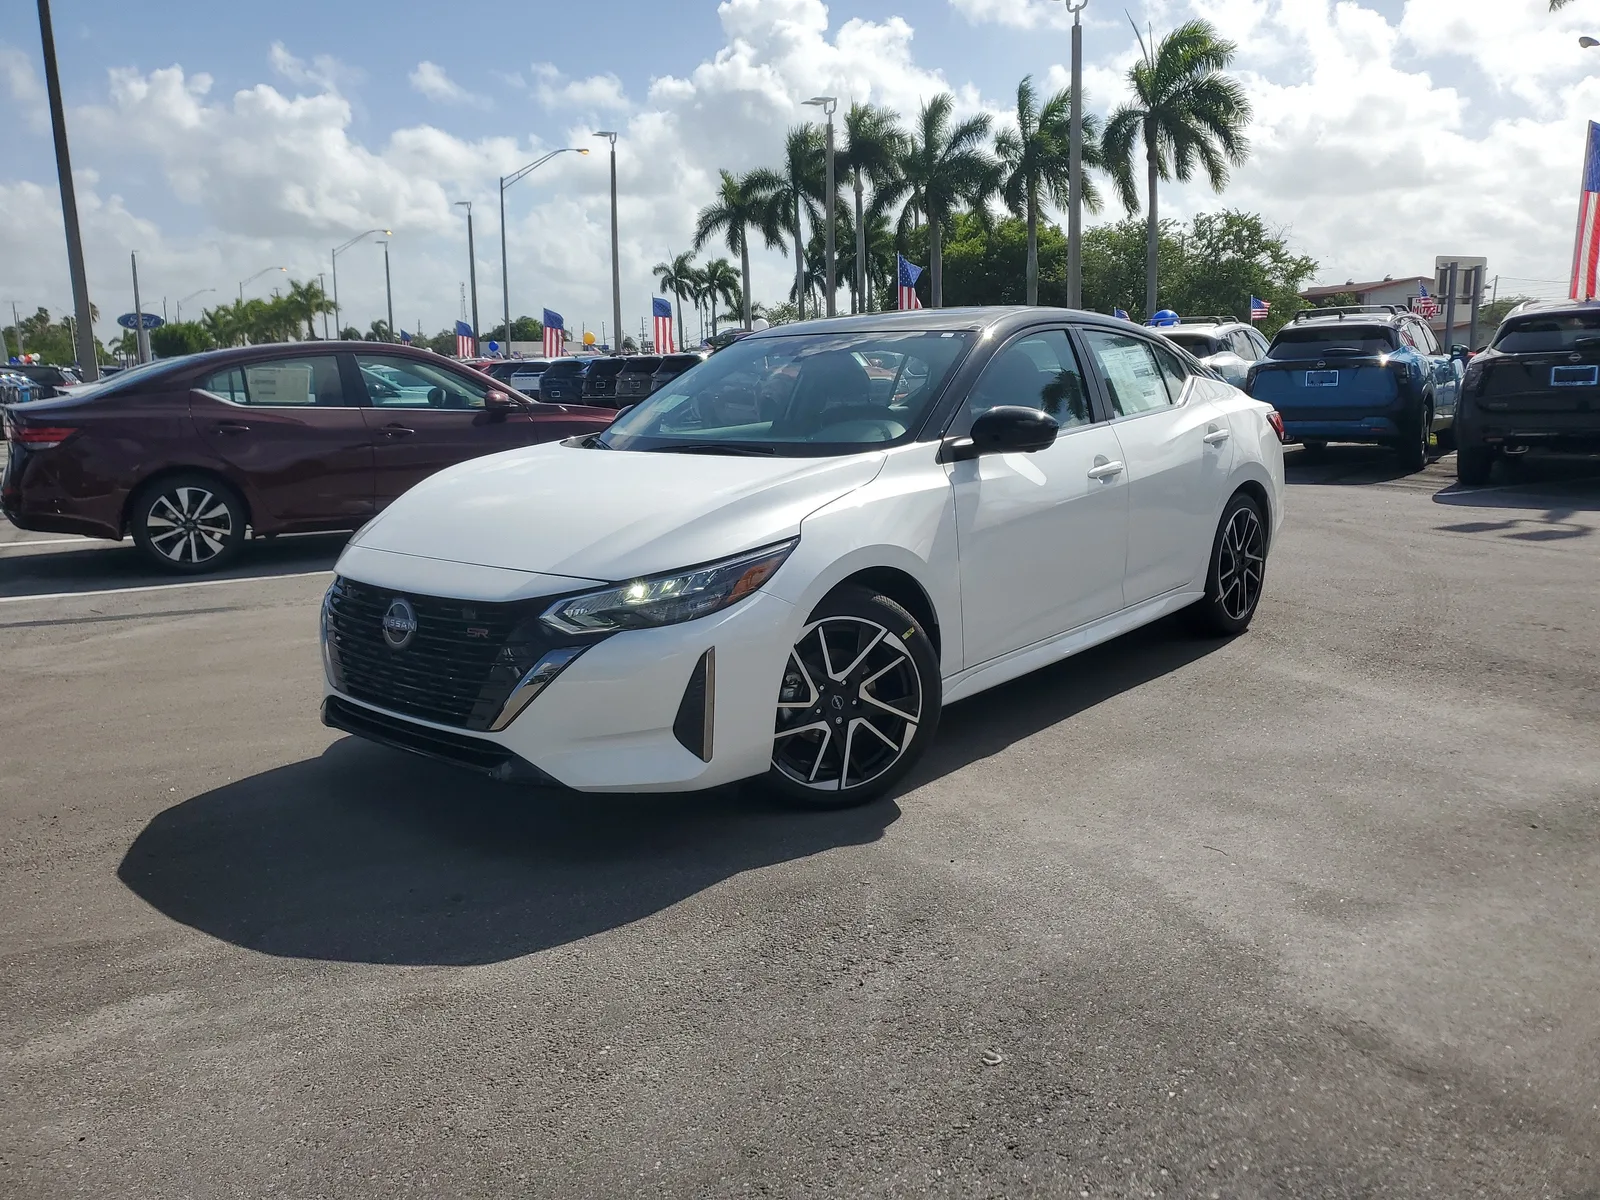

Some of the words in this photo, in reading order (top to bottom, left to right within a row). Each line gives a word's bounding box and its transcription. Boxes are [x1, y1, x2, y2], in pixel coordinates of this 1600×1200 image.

[127, 315, 155, 327] Frd
[383, 618, 415, 630] NISSAN
[466, 627, 489, 638] SR
